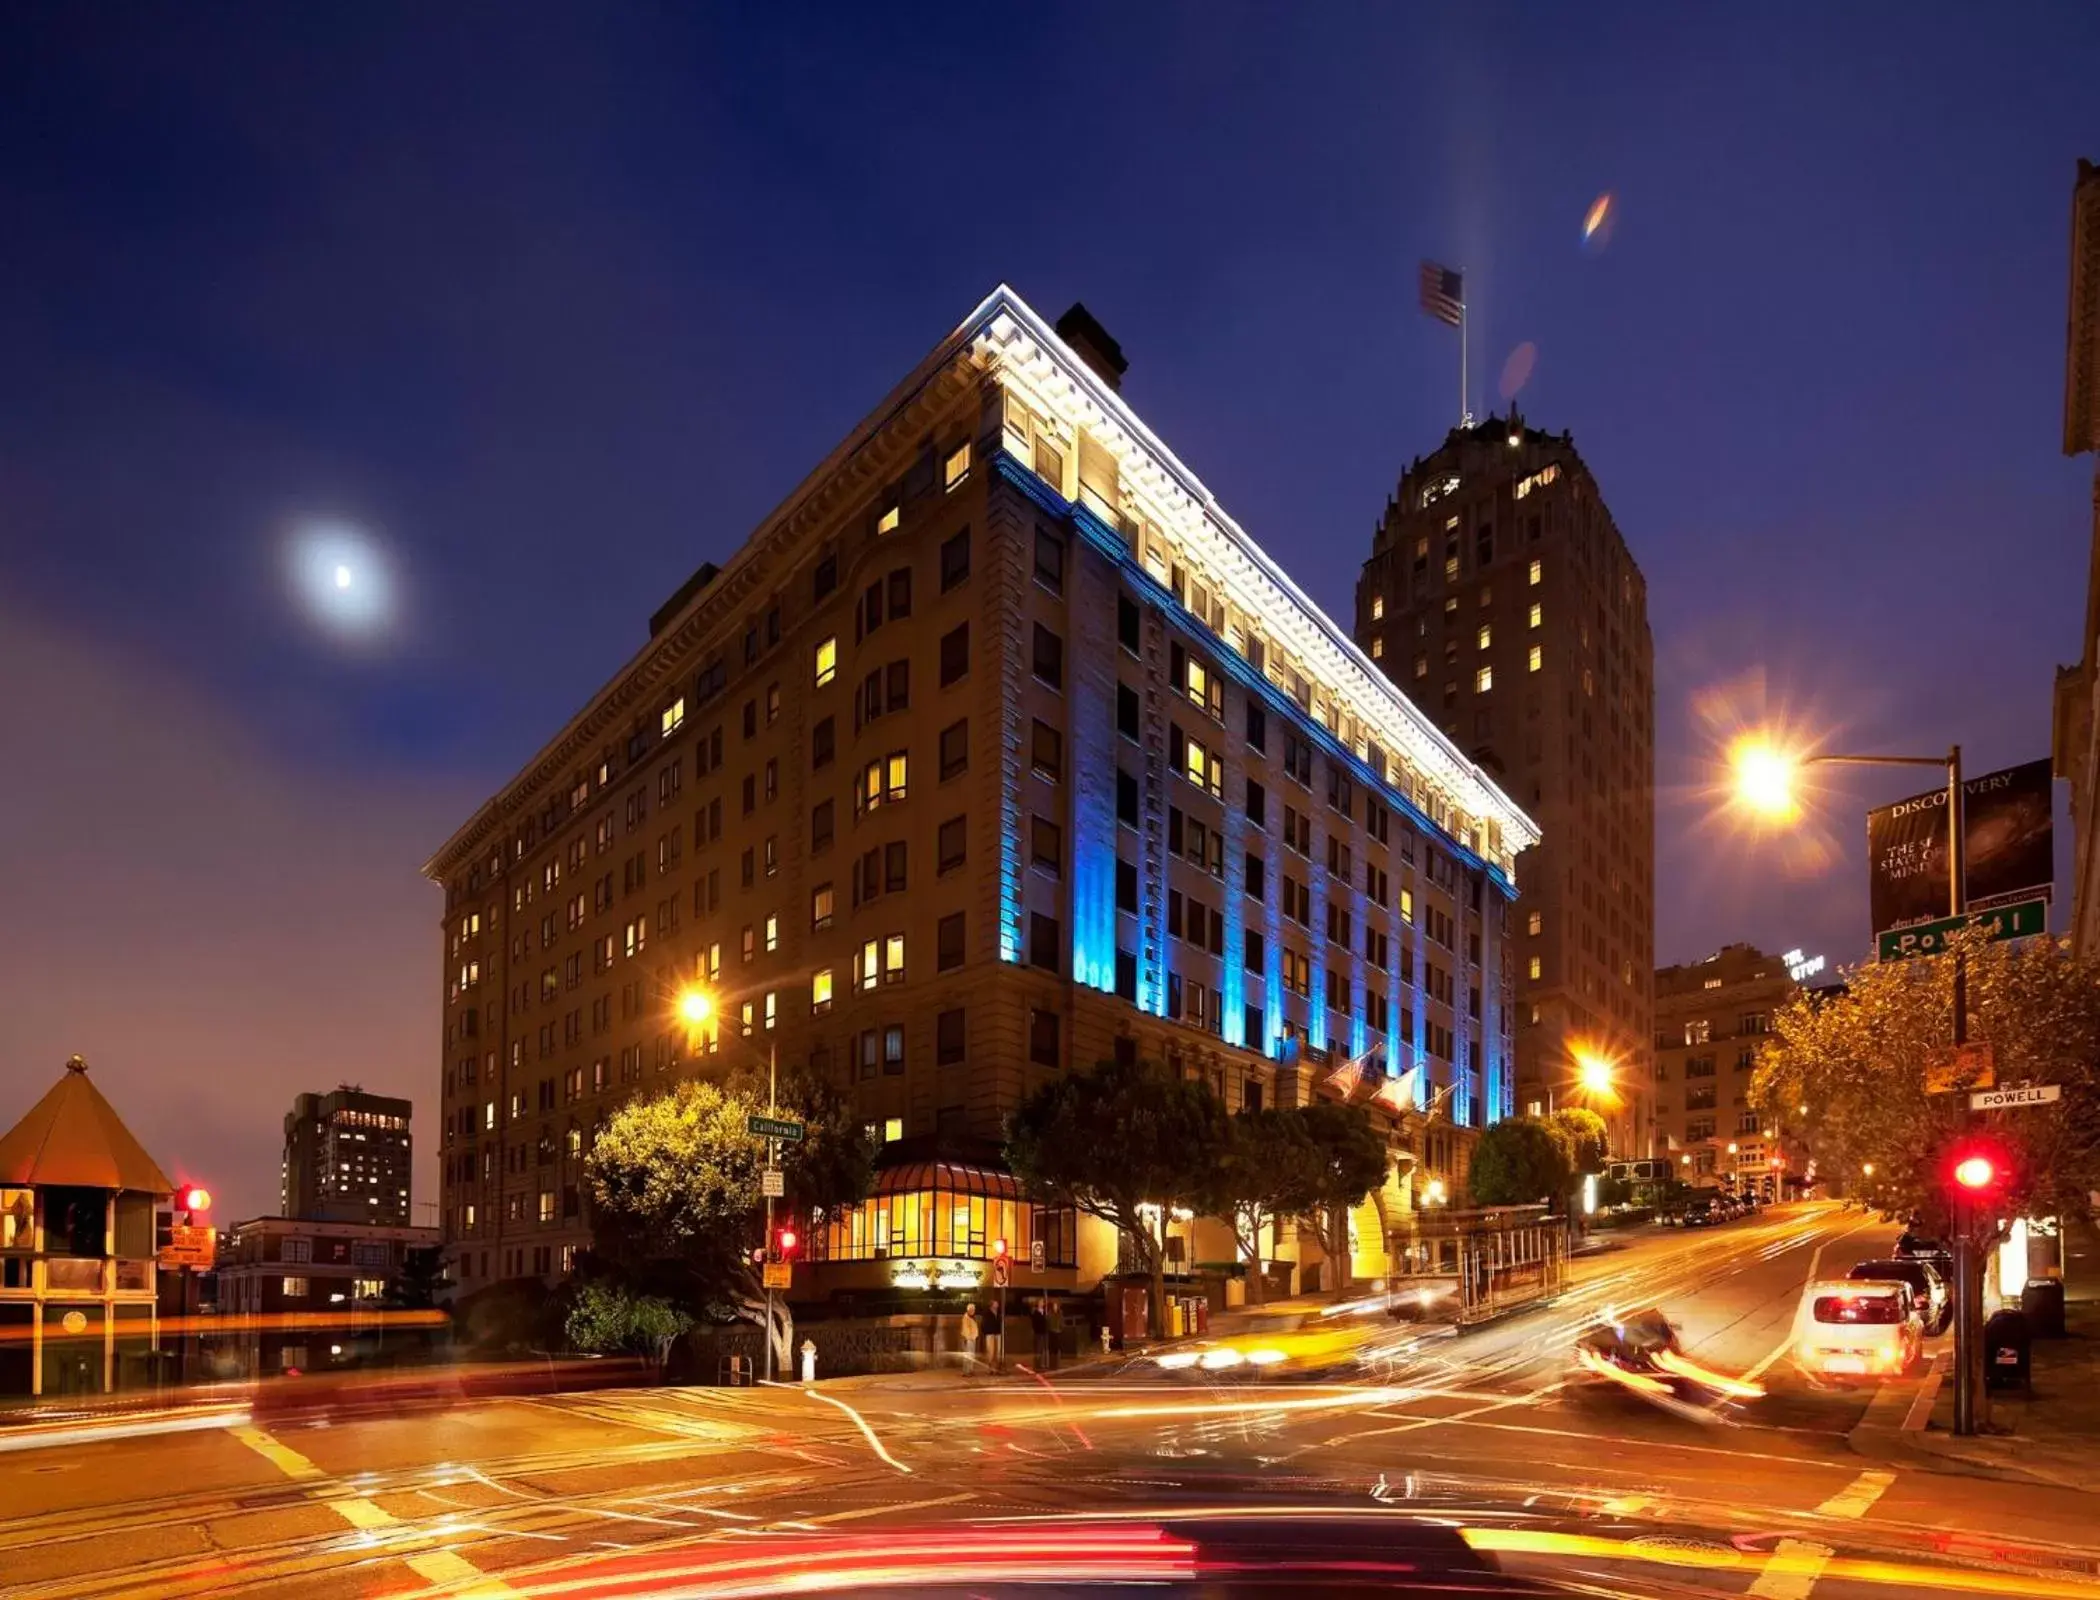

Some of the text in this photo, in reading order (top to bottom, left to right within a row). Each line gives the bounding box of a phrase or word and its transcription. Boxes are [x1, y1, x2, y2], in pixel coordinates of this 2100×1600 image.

[1886, 841, 1915, 858] THE
[1900, 912, 2020, 953] Powll
[1984, 1090, 2047, 1105] POWELL
[753, 1121, 798, 1136] California
